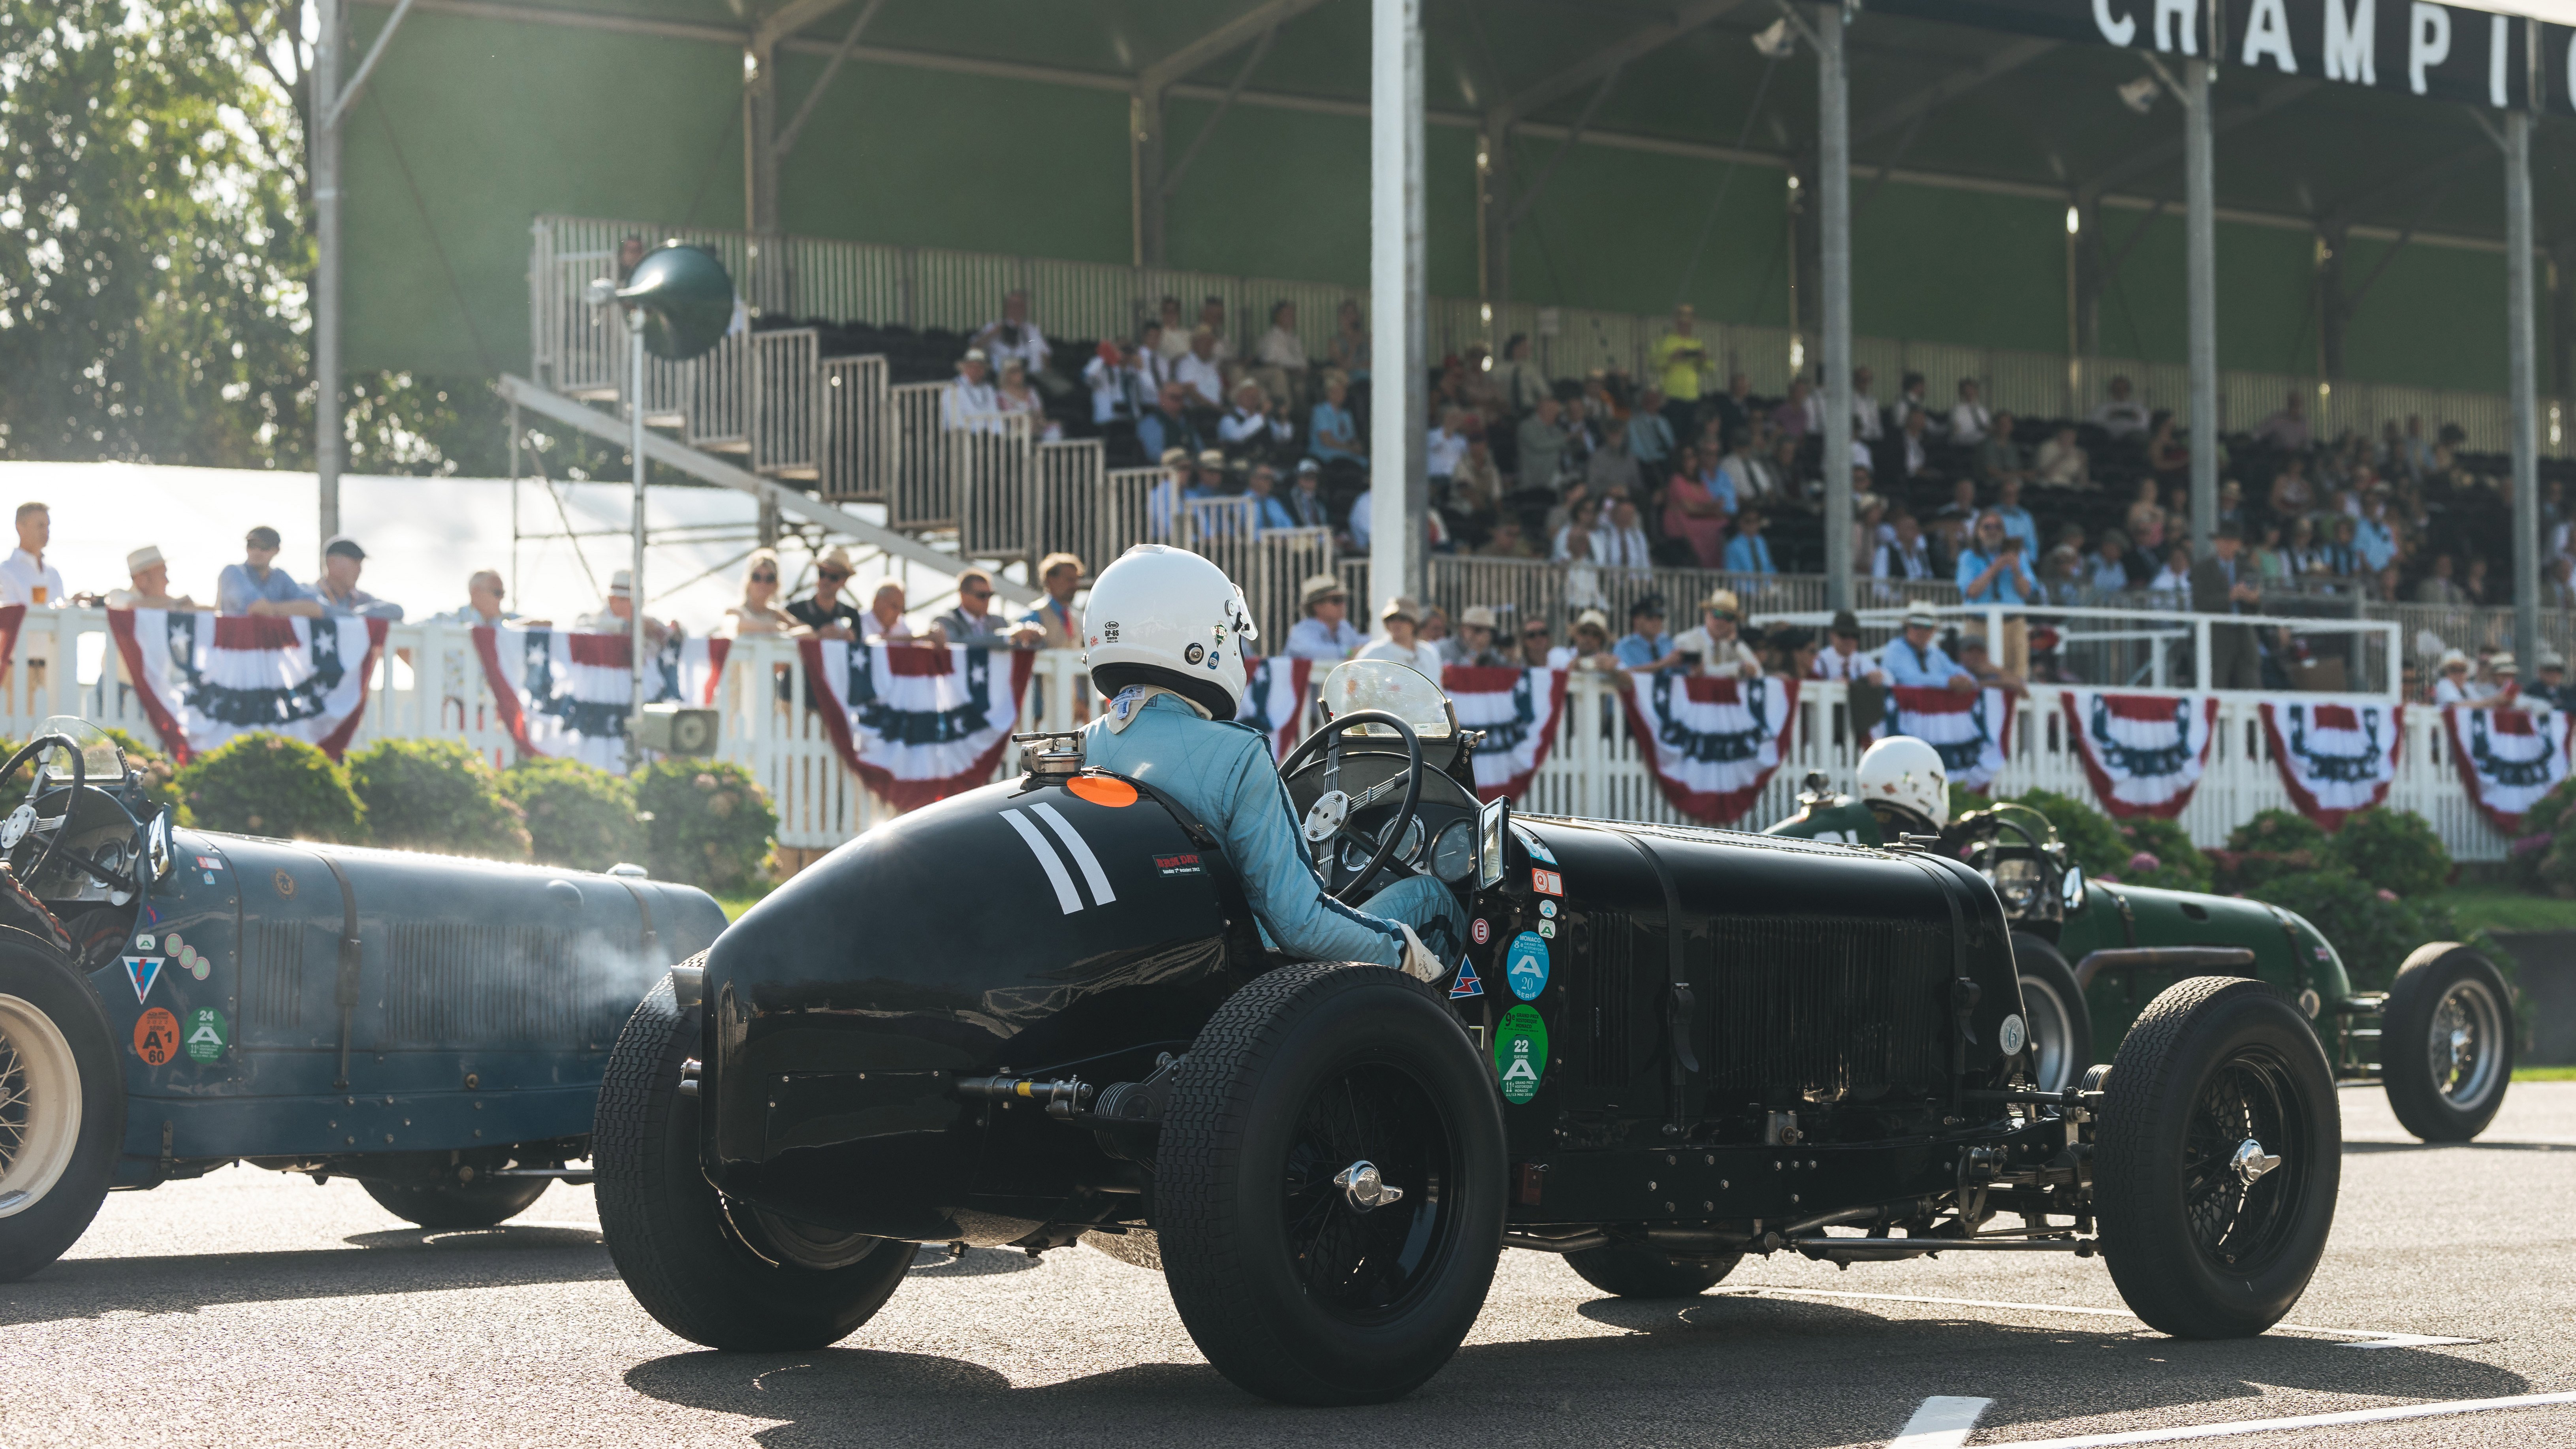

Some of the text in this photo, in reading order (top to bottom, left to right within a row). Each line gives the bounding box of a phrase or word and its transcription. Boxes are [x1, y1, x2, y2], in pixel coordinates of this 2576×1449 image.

[2091, 0, 2576, 114] CHAMPI
[998, 802, 1117, 915] 11
[1156, 854, 1199, 868] BRM DAY
[1537, 875, 1544, 885] Q
[1543, 907, 1553, 915] A
[1477, 925, 1484, 937] E
[1541, 926, 1553, 936] A
[1511, 955, 1544, 978] A
[1521, 977, 1533, 990] 20
[1517, 989, 1536, 999] SERIE
[199, 1010, 214, 1021] 24
[188, 1026, 223, 1045] A
[1514, 1040, 1528, 1052] 22
[148, 1050, 165, 1063] 60
[1502, 1059, 1538, 1080] A
